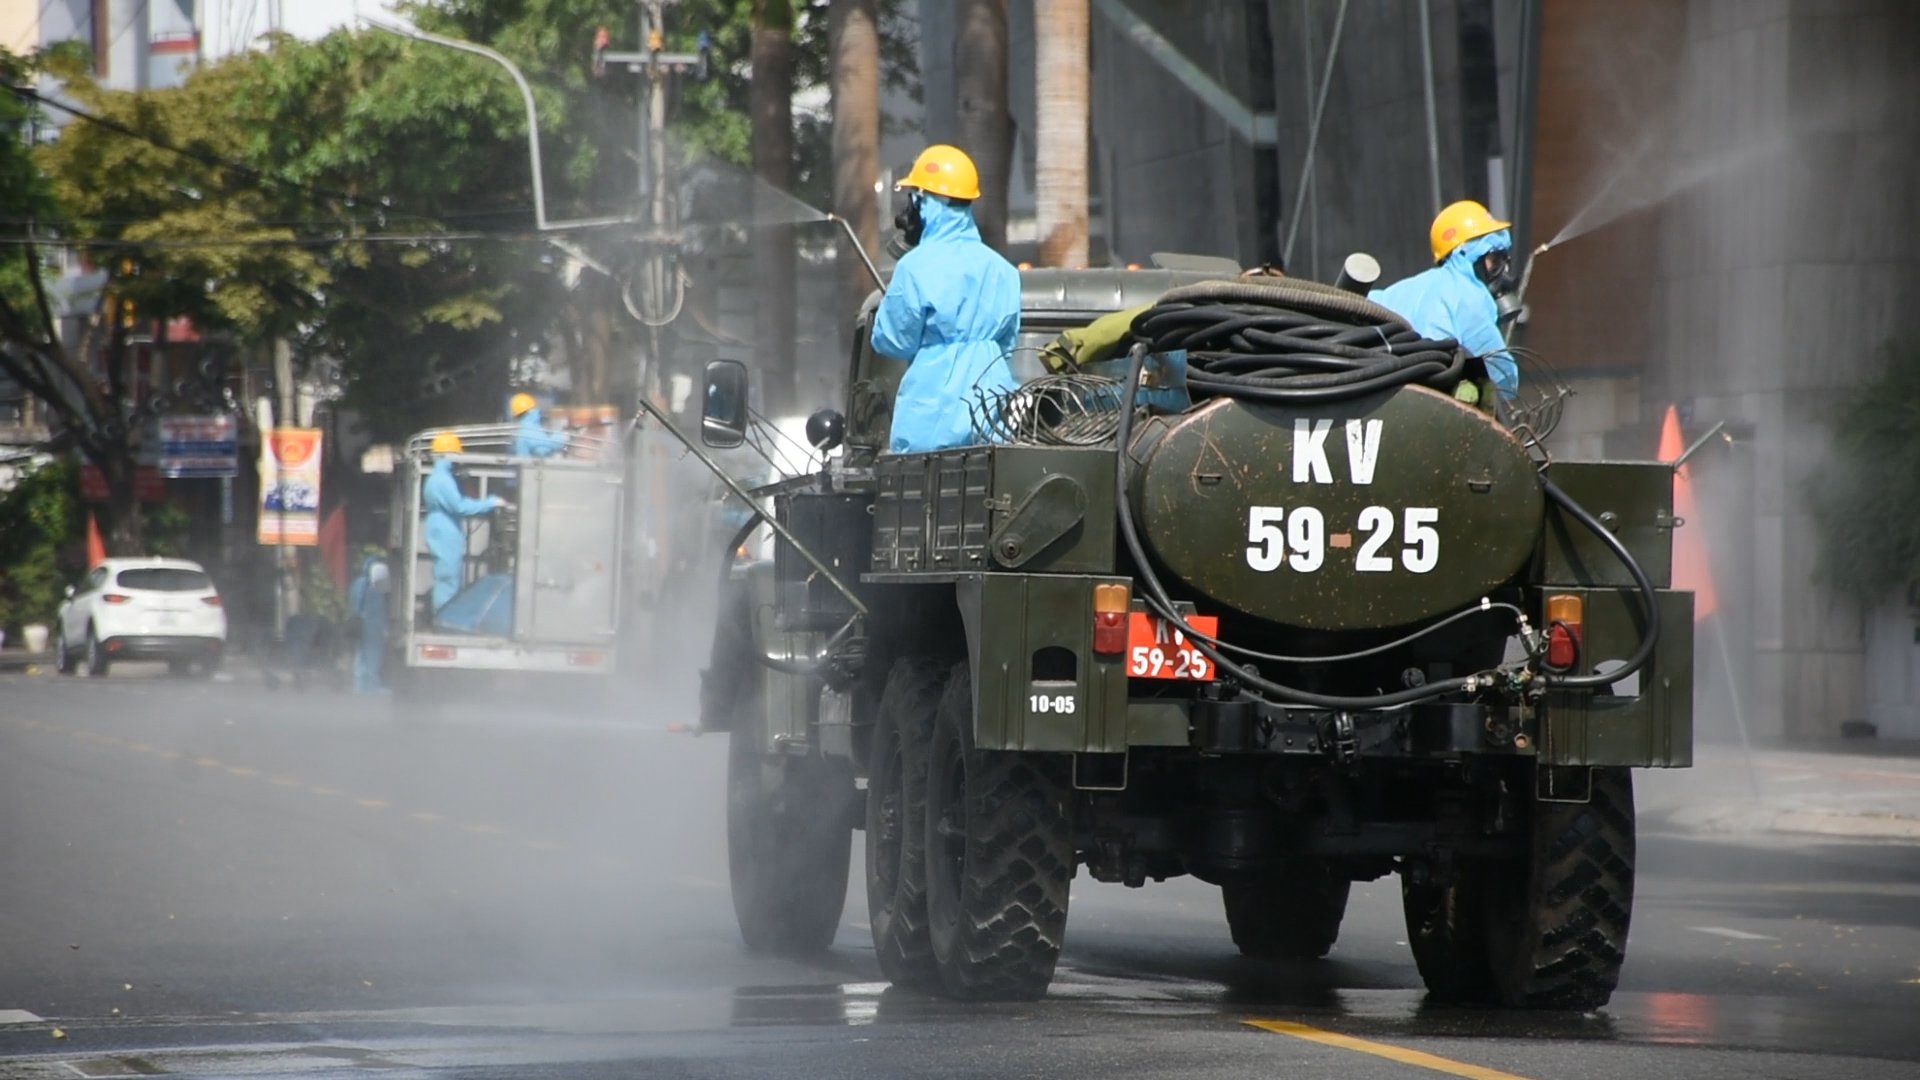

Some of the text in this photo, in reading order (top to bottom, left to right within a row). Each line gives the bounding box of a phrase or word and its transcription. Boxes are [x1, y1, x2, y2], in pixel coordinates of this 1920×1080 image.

[1246, 505, 1440, 574] 59-25
[1132, 646, 1207, 679] 59-25
[1029, 695, 1076, 714] 10-05
